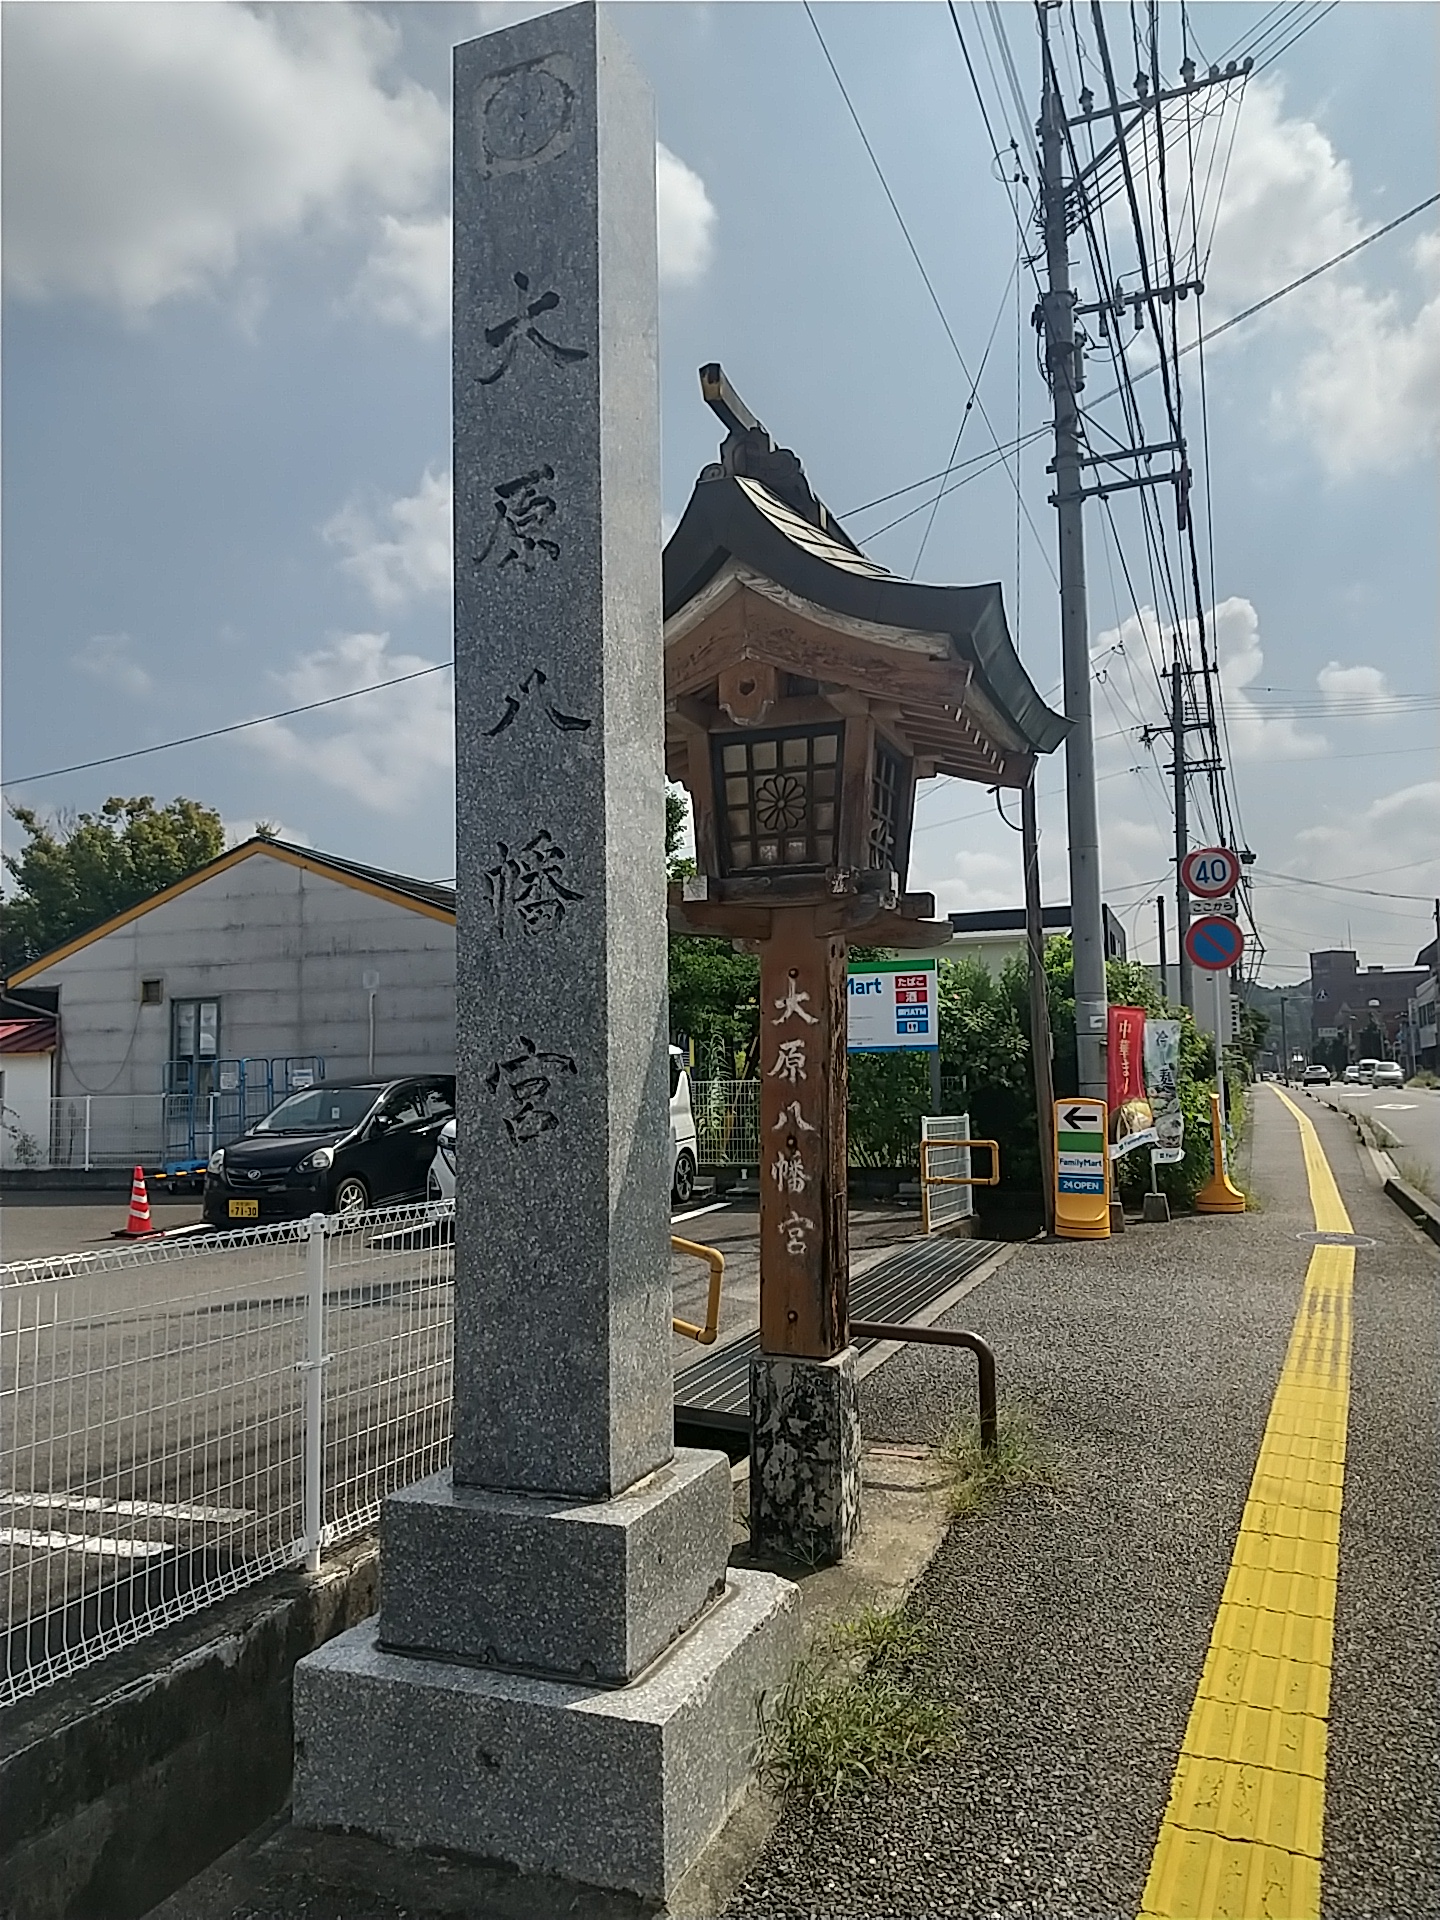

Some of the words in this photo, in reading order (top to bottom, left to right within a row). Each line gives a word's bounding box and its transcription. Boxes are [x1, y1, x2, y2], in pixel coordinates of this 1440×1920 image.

[474, 272, 592, 1147] 大原八幡宮
[1195, 859, 1227, 883] 40
[1193, 901, 1233, 912] ここから
[897, 976, 925, 988] たばこ
[767, 976, 820, 1255] 大原八幡宮
[1059, 1157, 1103, 1168] FamilyMart
